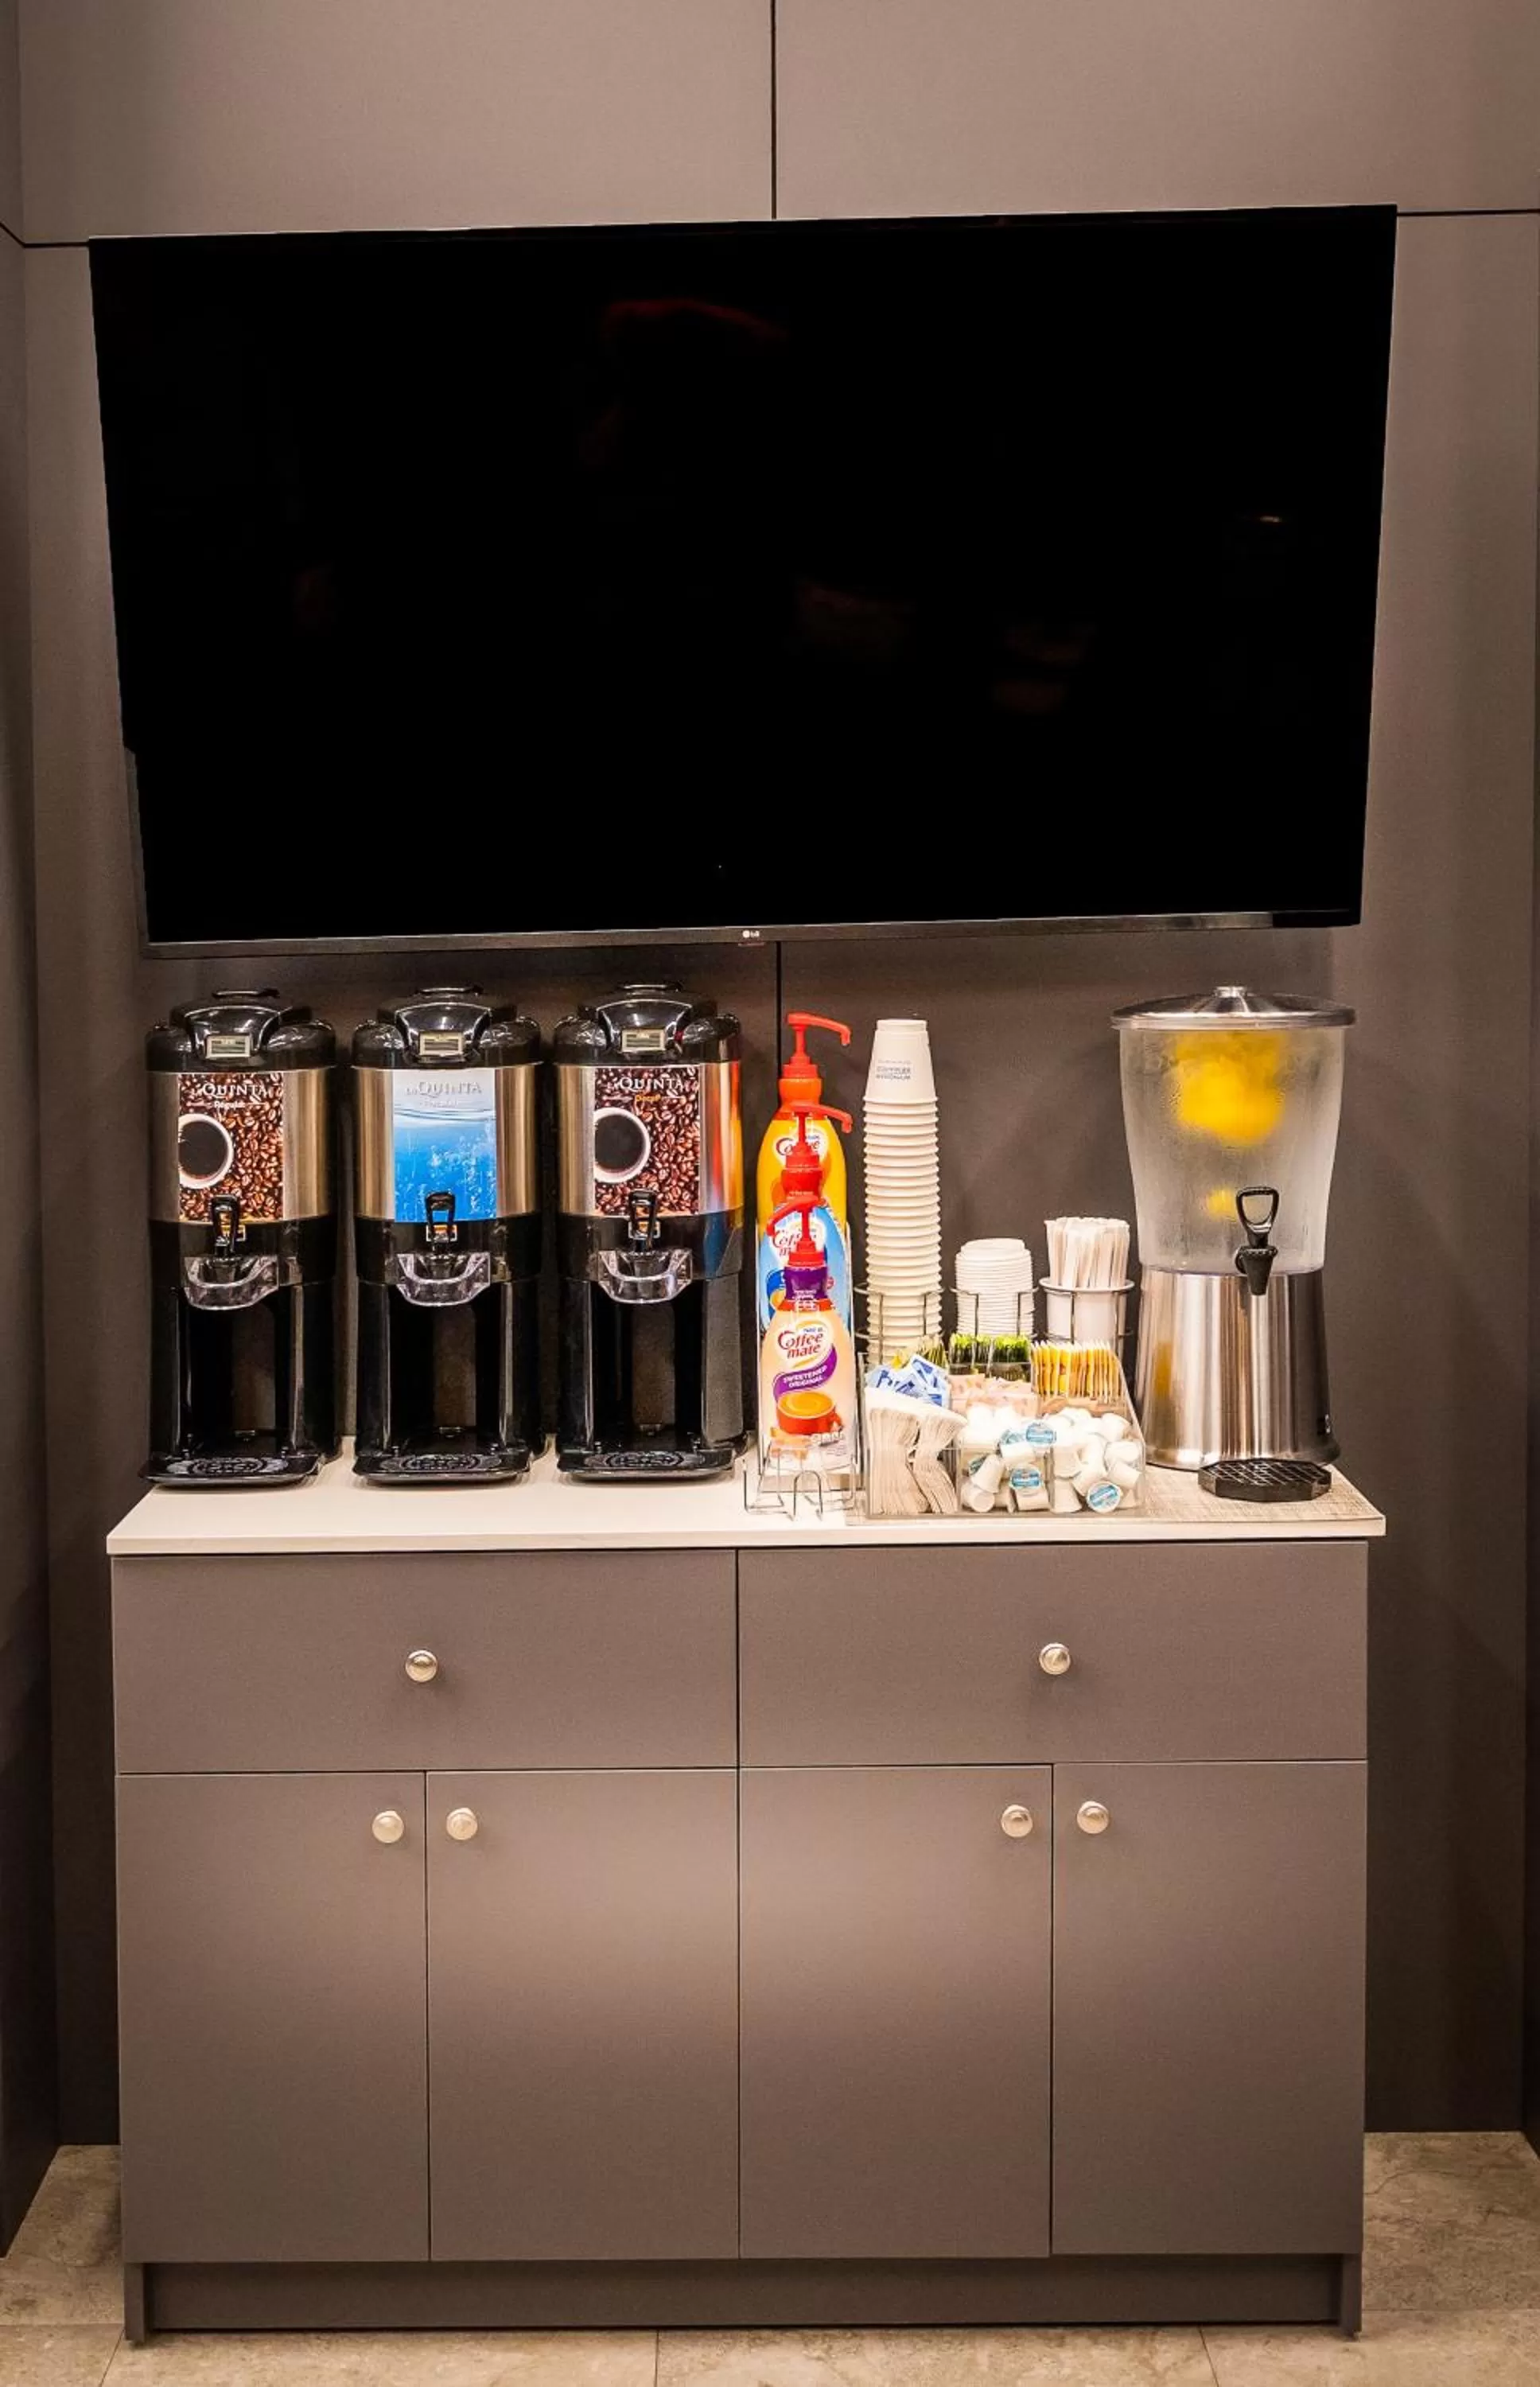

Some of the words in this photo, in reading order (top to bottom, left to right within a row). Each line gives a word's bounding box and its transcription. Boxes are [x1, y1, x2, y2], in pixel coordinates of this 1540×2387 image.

[203, 1082, 268, 1099] QUINTA
[418, 1081, 483, 1099] QUINTA
[620, 1077, 684, 1092] QUINTA
[777, 1330, 824, 1350] Coffee
[786, 1344, 822, 1359] mate
